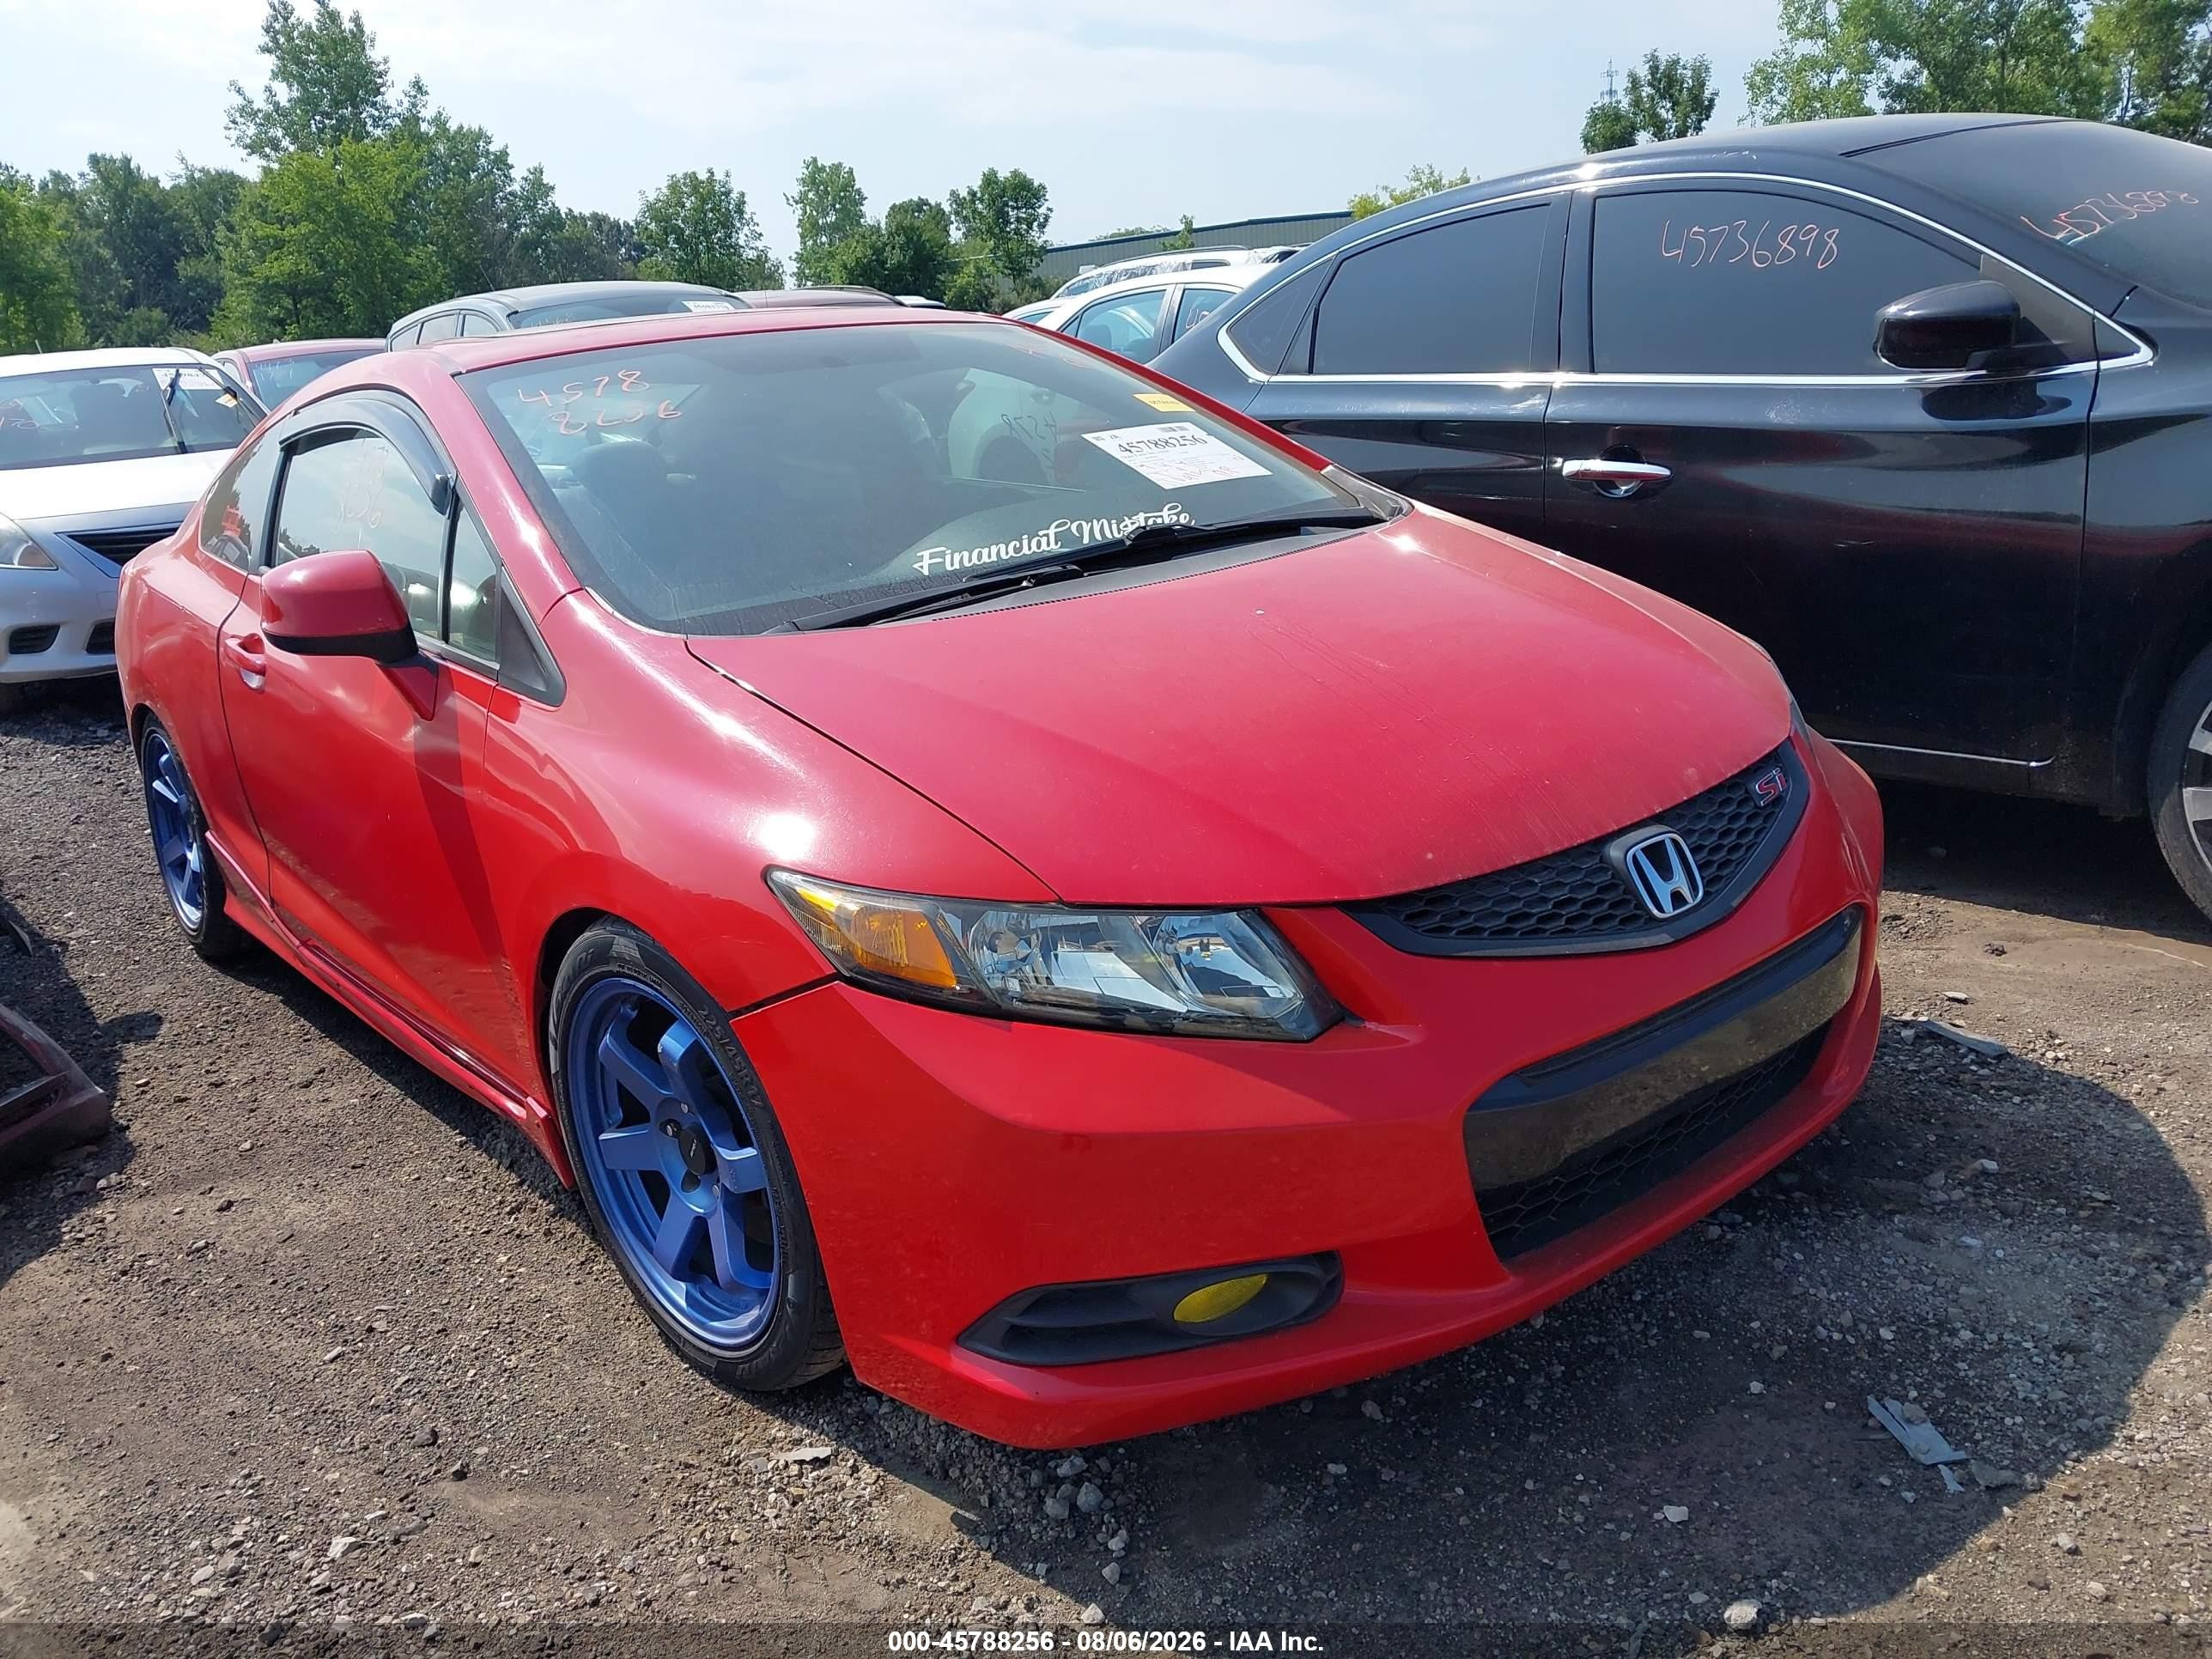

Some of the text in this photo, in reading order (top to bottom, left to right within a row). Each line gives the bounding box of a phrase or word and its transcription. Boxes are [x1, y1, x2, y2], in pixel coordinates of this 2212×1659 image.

[1662, 220, 1839, 270] 45736898
[517, 369, 649, 407] 4578
[1117, 434, 1208, 454] 45788256
[912, 518, 1071, 576] Financial
